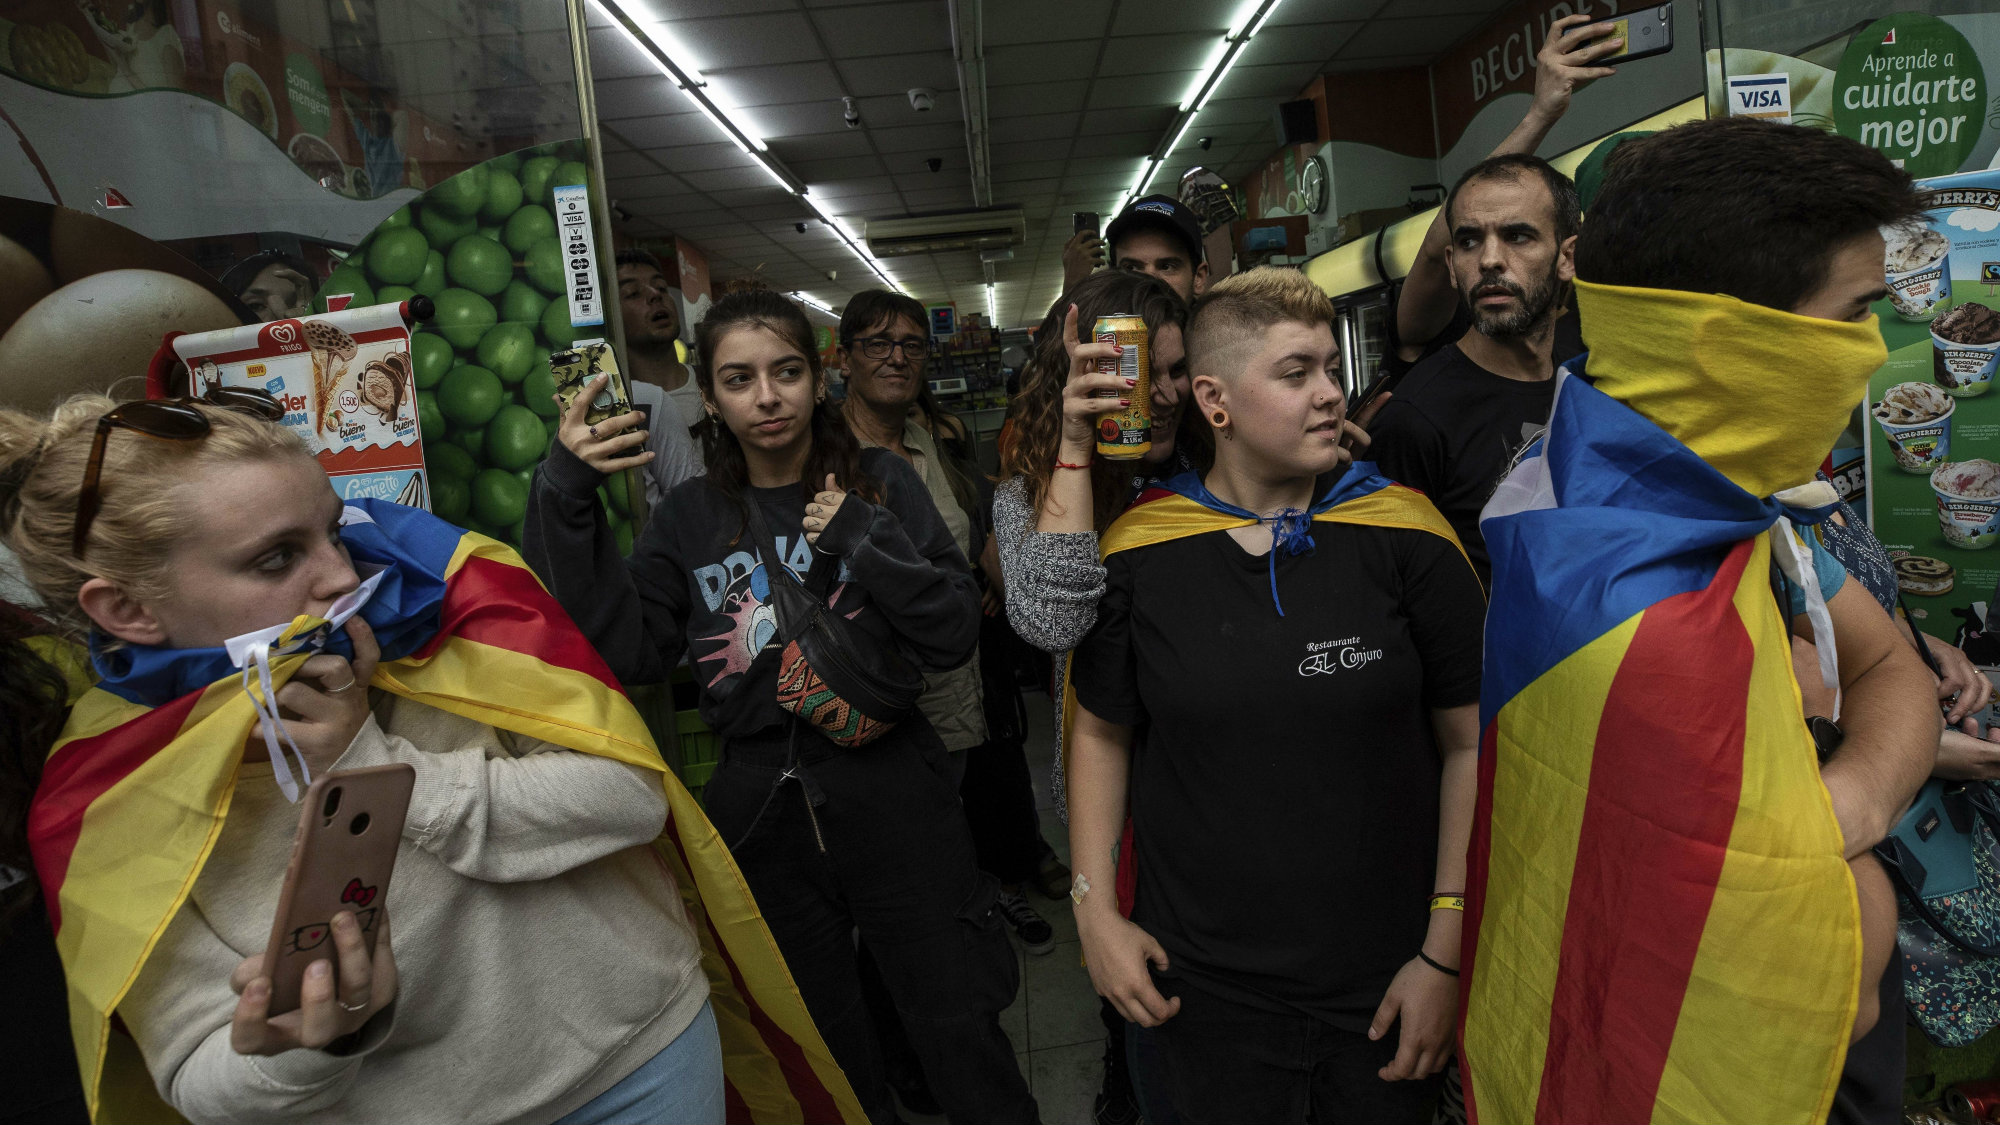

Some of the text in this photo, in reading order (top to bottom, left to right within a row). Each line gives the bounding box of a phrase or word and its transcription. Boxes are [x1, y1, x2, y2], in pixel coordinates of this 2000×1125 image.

[1862, 48, 1954, 77] Aprende a
[286, 68, 310, 91] Som
[1738, 89, 1782, 109] VISA
[1843, 72, 1977, 110] cuidarte
[288, 88, 330, 117] mengem
[1860, 108, 1967, 158] mejor
[1934, 191, 2000, 207] JERRY'S
[1906, 282, 1931, 292] Cookie
[1909, 287, 1931, 297] Dough
[280, 344, 303, 353] FRIGO
[247, 365, 264, 375] NUEVO
[279, 393, 308, 412] der
[341, 396, 358, 407] 1,50€
[281, 412, 309, 426] EAM
[393, 418, 415, 433] bueno
[340, 424, 366, 439] bueno
[344, 475, 399, 500] Cornetto
[1832, 464, 1865, 497] BE
[1306, 636, 1361, 652] Restaurante
[1340, 646, 1383, 670] Conjuro
